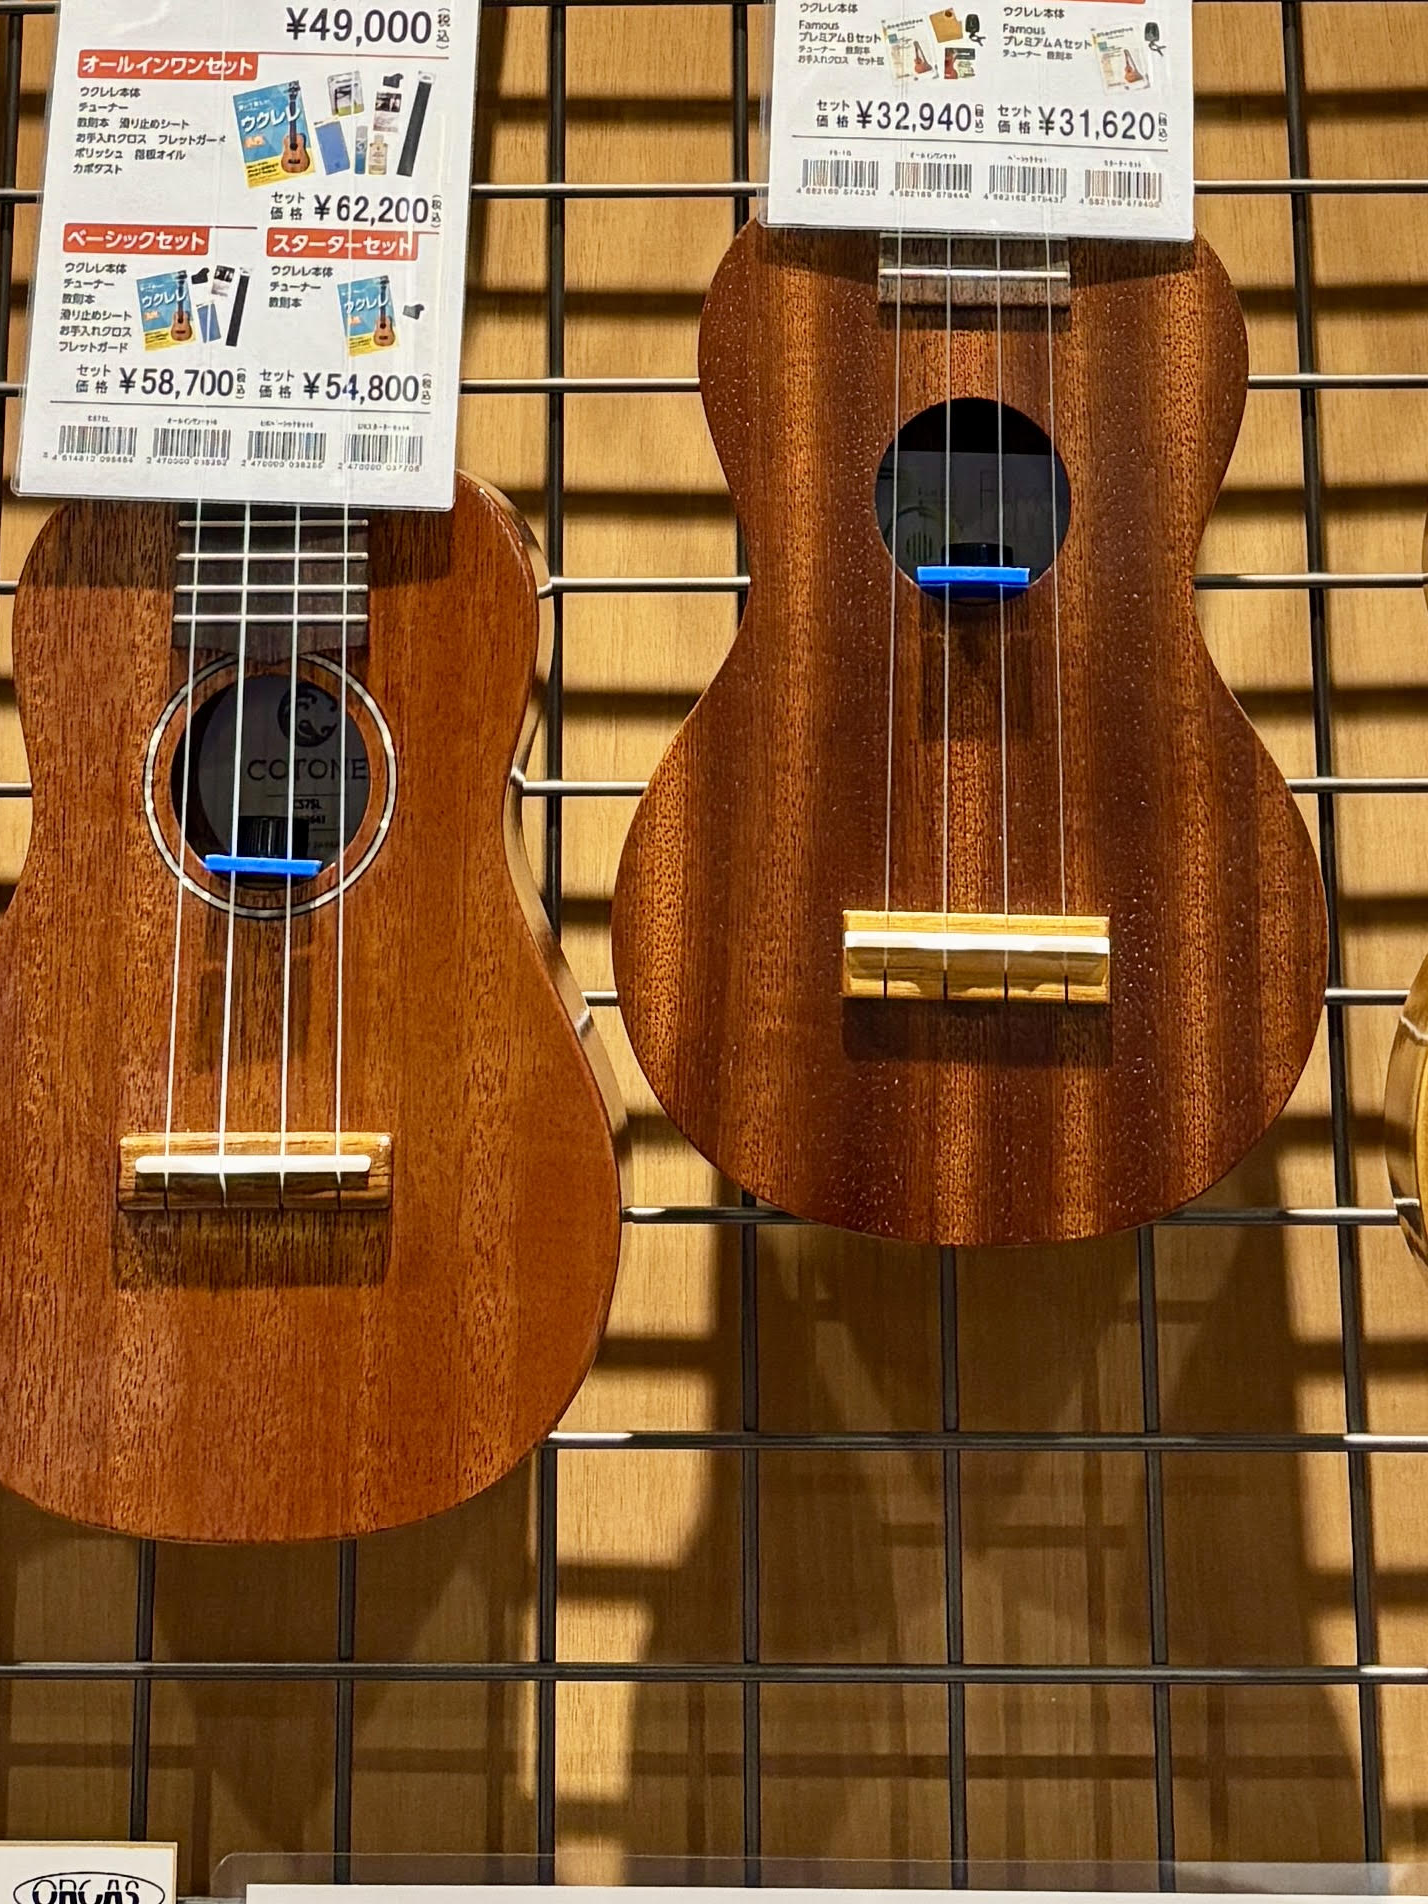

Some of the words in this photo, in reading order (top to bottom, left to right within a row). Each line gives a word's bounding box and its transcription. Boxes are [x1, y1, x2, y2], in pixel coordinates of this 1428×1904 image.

[284, 6, 433, 46] ¥49,000
[81, 54, 253, 77] オールインワンセット
[855, 101, 972, 134] ¥32,940
[1038, 108, 1155, 143] ¥31,620
[313, 194, 430, 227] ¥62,200
[66, 229, 206, 252] ベーシックセット
[272, 234, 413, 258] スターターセット
[118, 366, 235, 401] ¥58,700
[302, 371, 420, 407] ¥54,800
